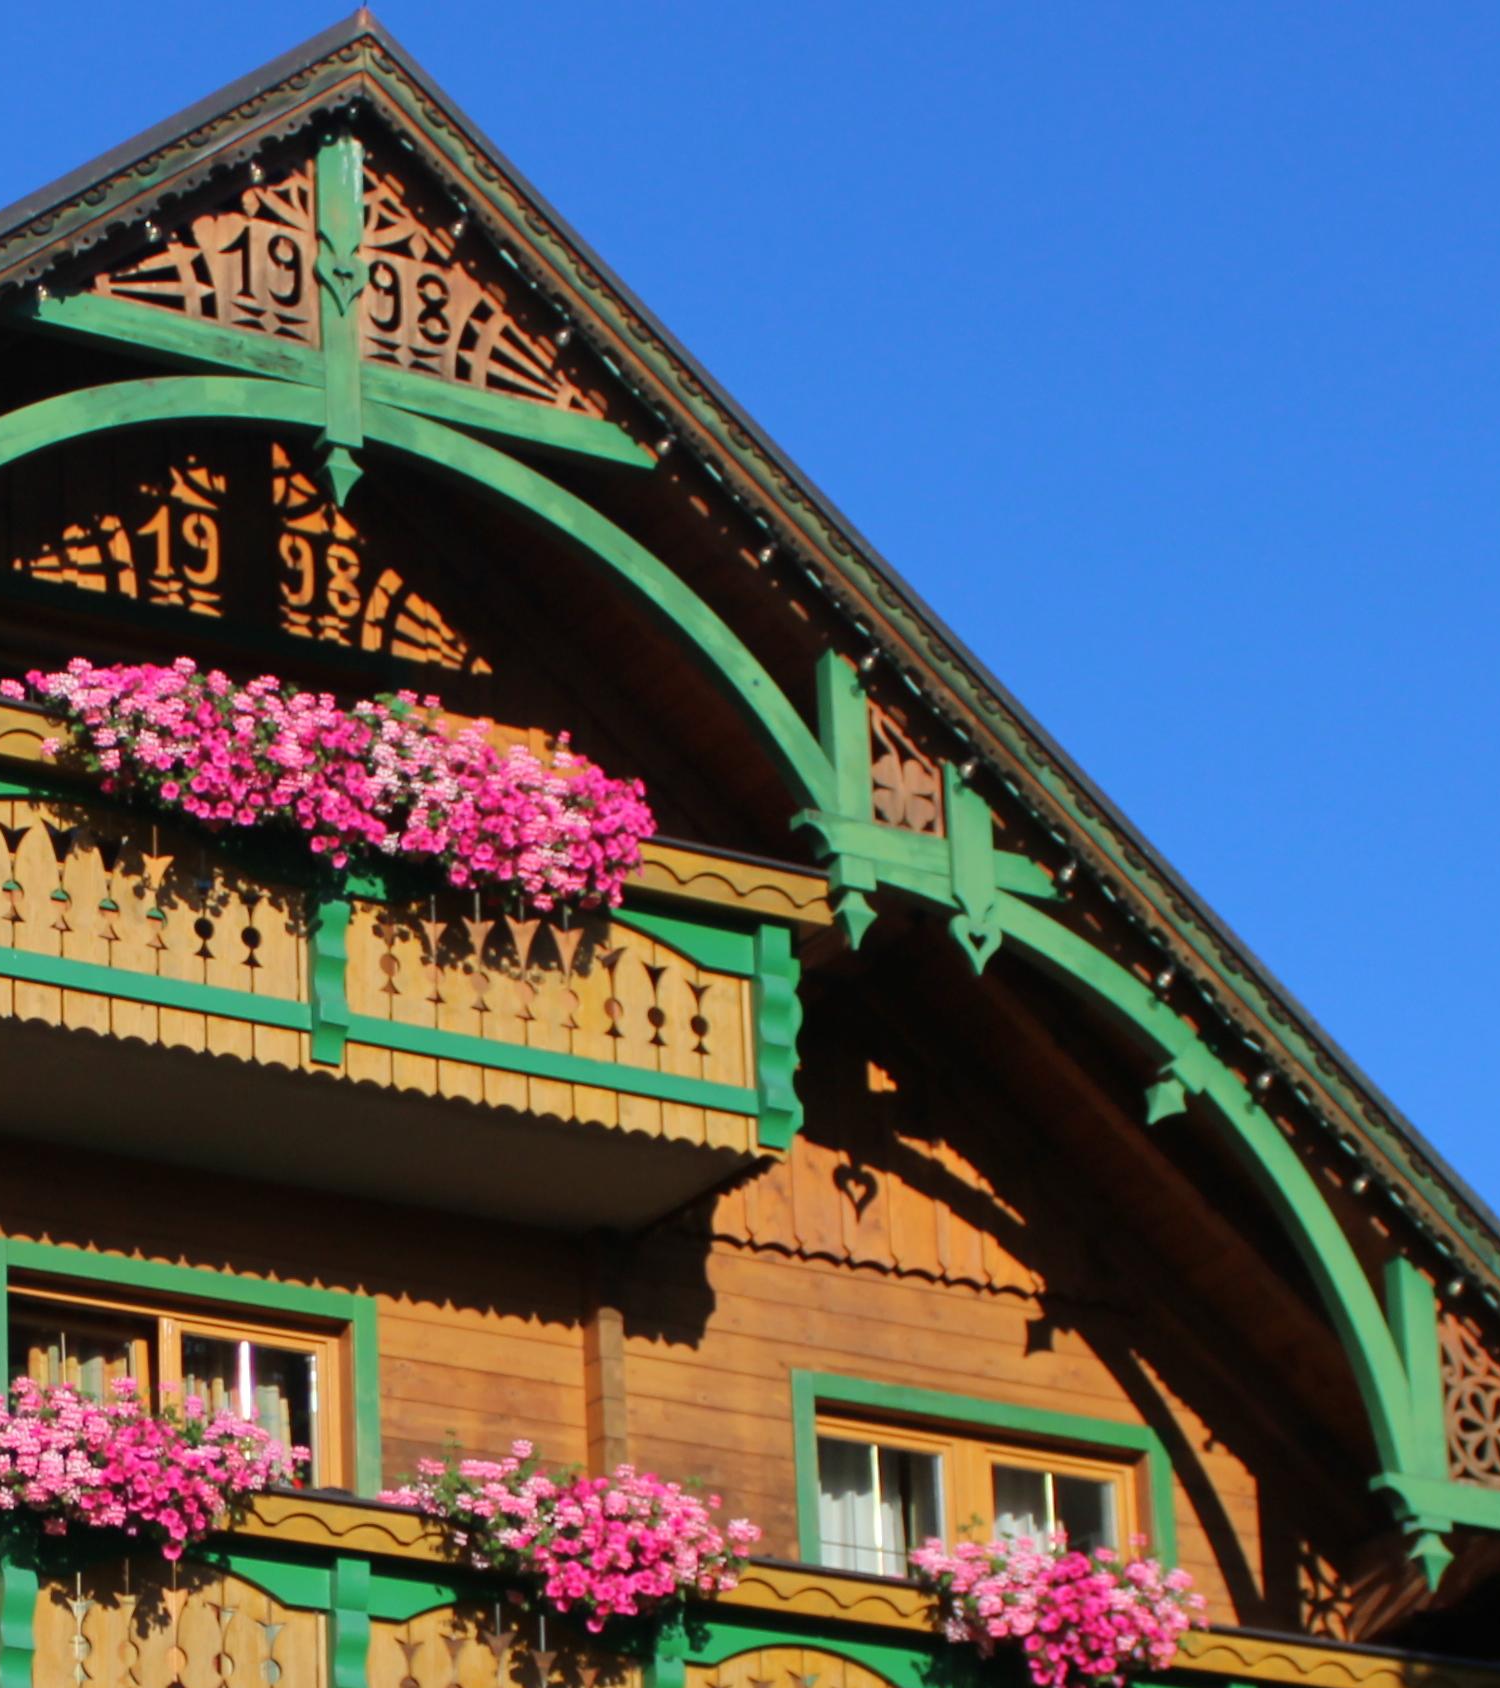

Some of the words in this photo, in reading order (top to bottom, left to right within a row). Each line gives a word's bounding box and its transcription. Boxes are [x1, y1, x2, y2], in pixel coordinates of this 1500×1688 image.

[217, 226, 303, 307] 19
[368, 262, 450, 345] 98
[137, 505, 219, 585] 19
[278, 534, 361, 618] 98
